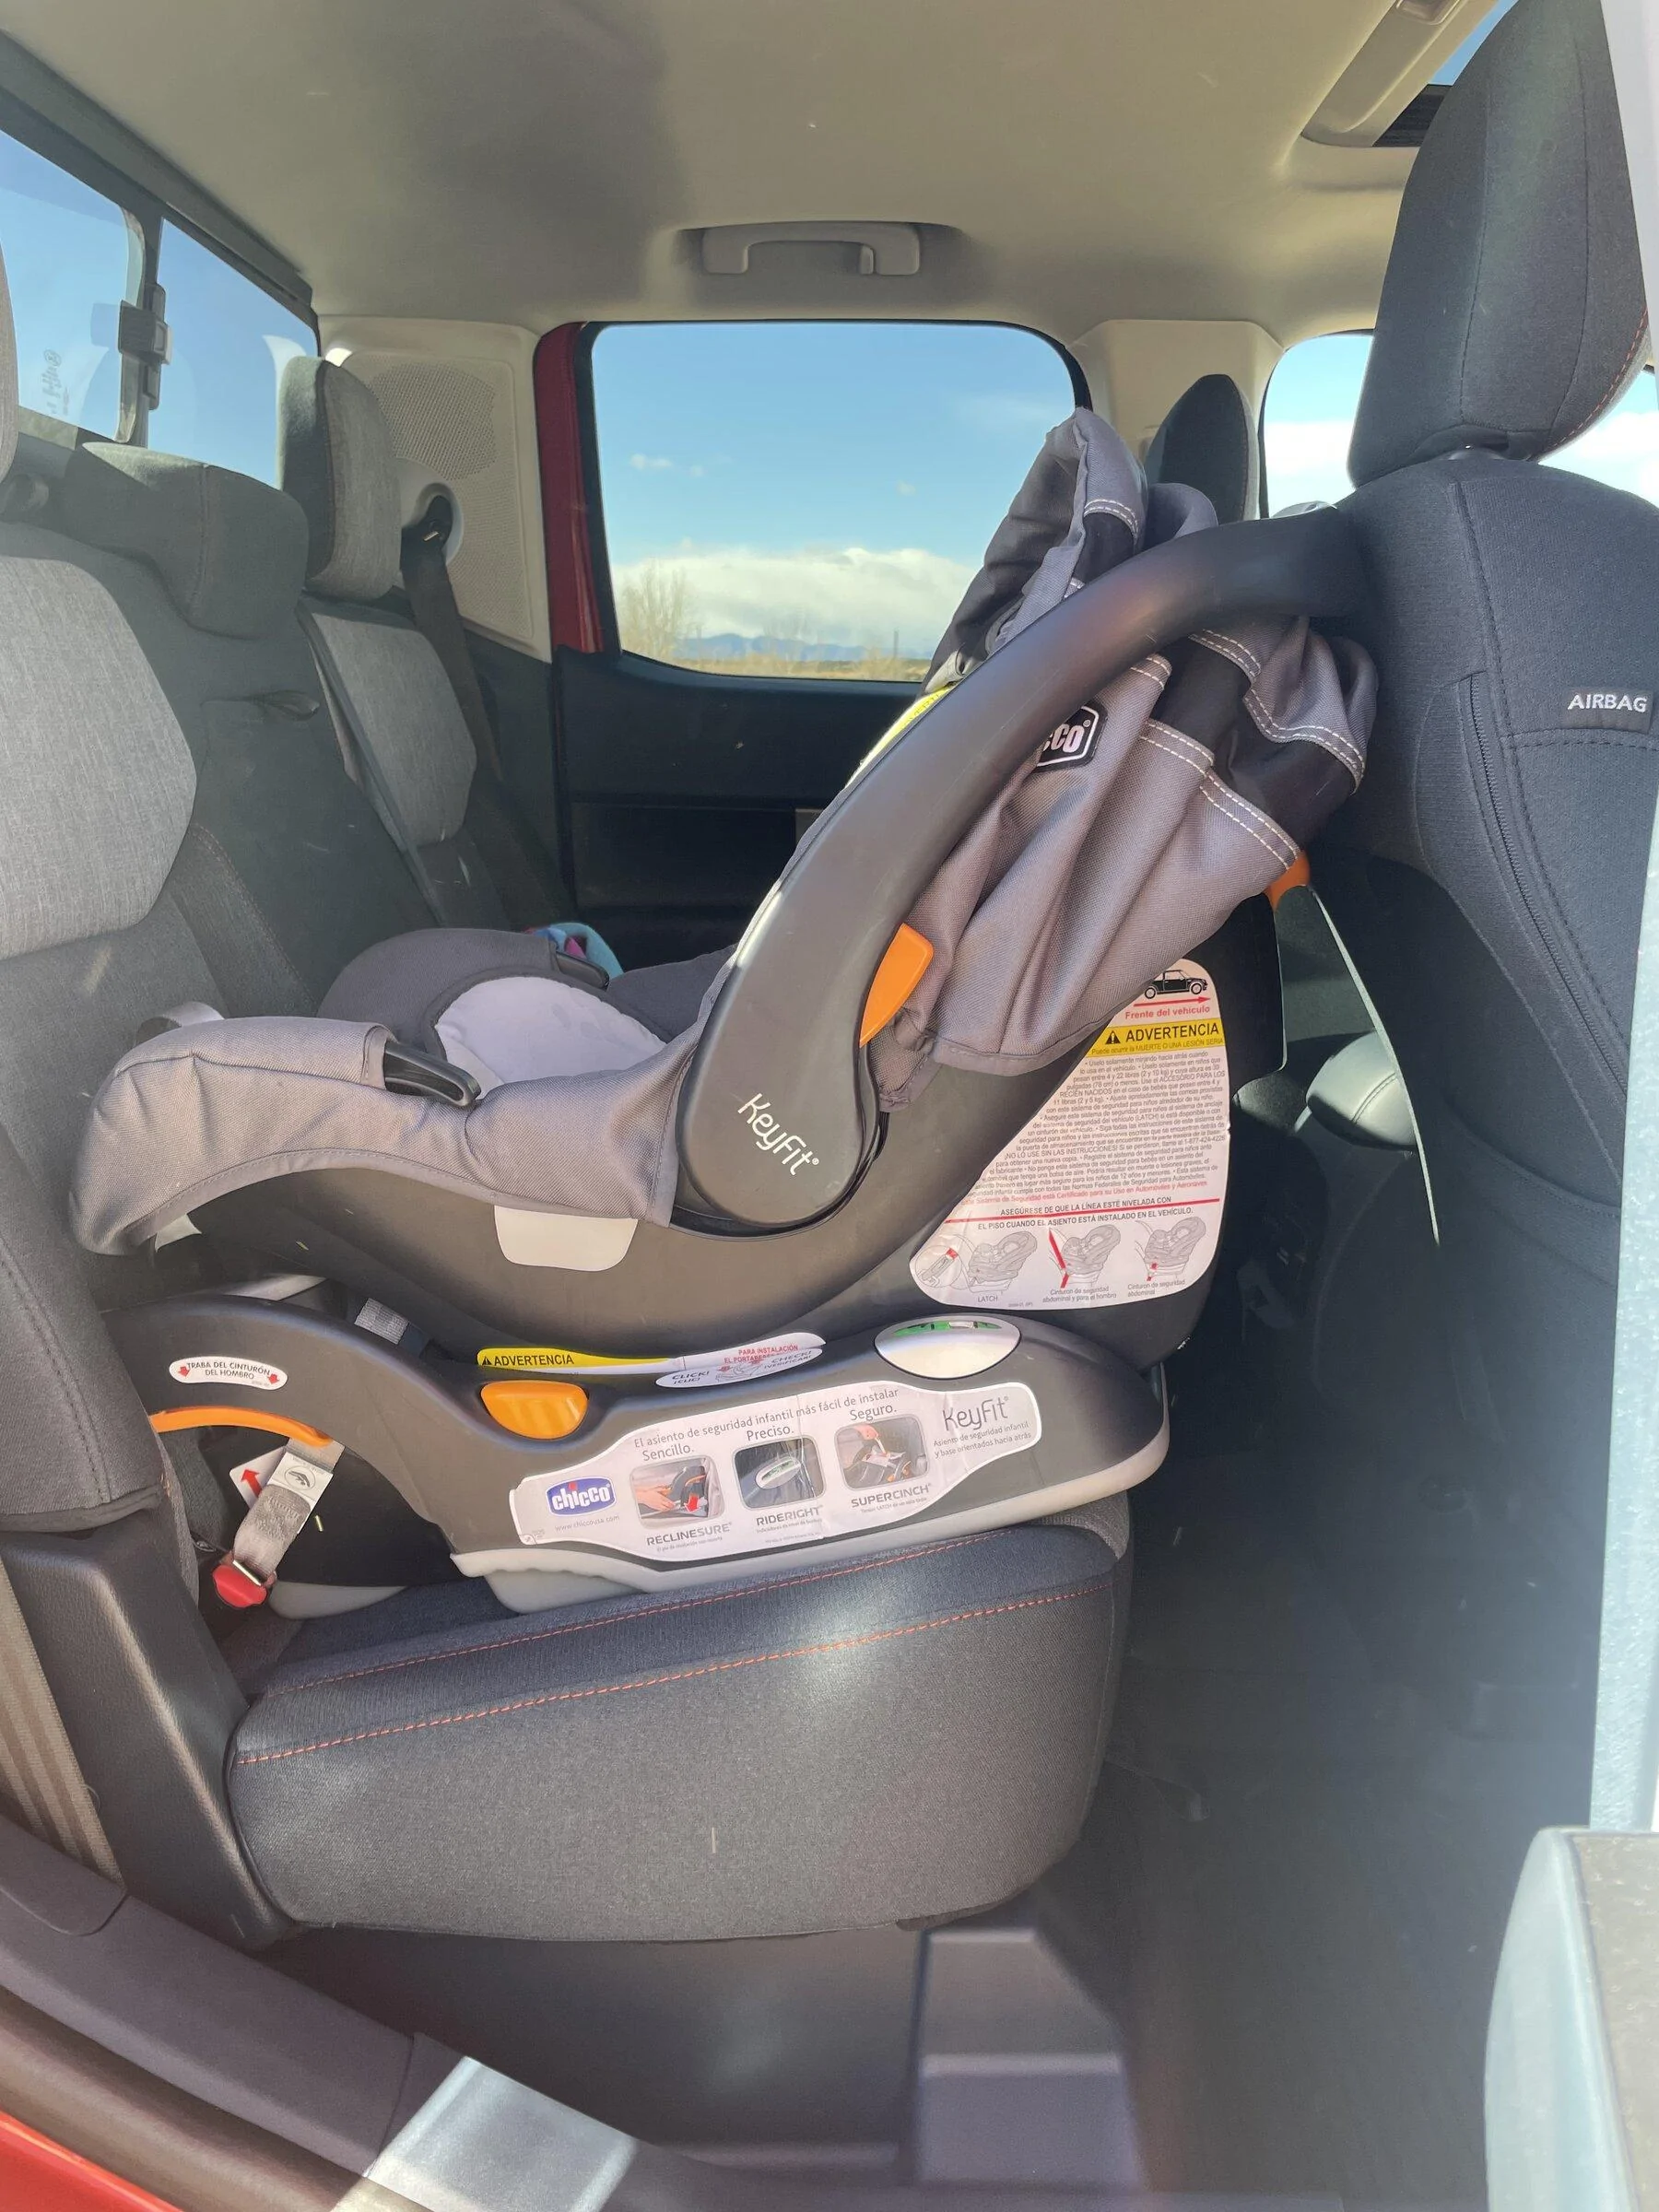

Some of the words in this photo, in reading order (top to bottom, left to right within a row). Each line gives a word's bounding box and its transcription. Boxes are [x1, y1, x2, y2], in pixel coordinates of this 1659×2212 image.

[1567, 693, 1647, 712] AIRBAG
[1125, 1010, 1155, 1019] Frente
[1126, 1023, 1219, 1041] ADVERTENCIA
[1135, 1043, 1161, 1052] MUERTE
[1085, 1088, 1112, 1096] NACIDOS
[1131, 1177, 1159, 1186] Seguridad
[1001, 1206, 1042, 1216] ASEGÚRESE
[1081, 1202, 1101, 1210] LÍNEA
[1122, 1197, 1156, 1206] NIVELADA
[1006, 1219, 1036, 1229] CUANDO
[1048, 1217, 1077, 1225] ASIENTO
[1098, 1212, 1135, 1221] INSTALADO
[978, 1294, 998, 1302] LATCH
[757, 1344, 797, 1354] INSTALACIÓN
[494, 1354, 574, 1365] ADVERTENCIA
[219, 1370, 253, 1379] HOMBRO
[229, 1362, 270, 1375] CINTURÓN
[634, 1438, 643, 1448] El
[647, 1431, 684, 1445] asiento
[688, 1428, 700, 1438] de
[703, 1418, 752, 1437] seguridad
[757, 1409, 794, 1424] infantil
[797, 1405, 816, 1416] más
[818, 1399, 841, 1411] fácil
[844, 1396, 856, 1406] de
[860, 1388, 899, 1403] instalar
[850, 1402, 897, 1424] Seguro.
[747, 1423, 794, 1441] Preciso.
[935, 1437, 958, 1446] Asiento
[970, 1427, 1003, 1440] seguridad
[1005, 1422, 1030, 1432] infantil
[642, 1441, 694, 1461] Sencillo.
[941, 1448, 955, 1456] base
[959, 1441, 993, 1453] orientados
[994, 1436, 1012, 1444] hacia
[1014, 1431, 1031, 1441] atrás
[550, 1481, 611, 1510] chicco
